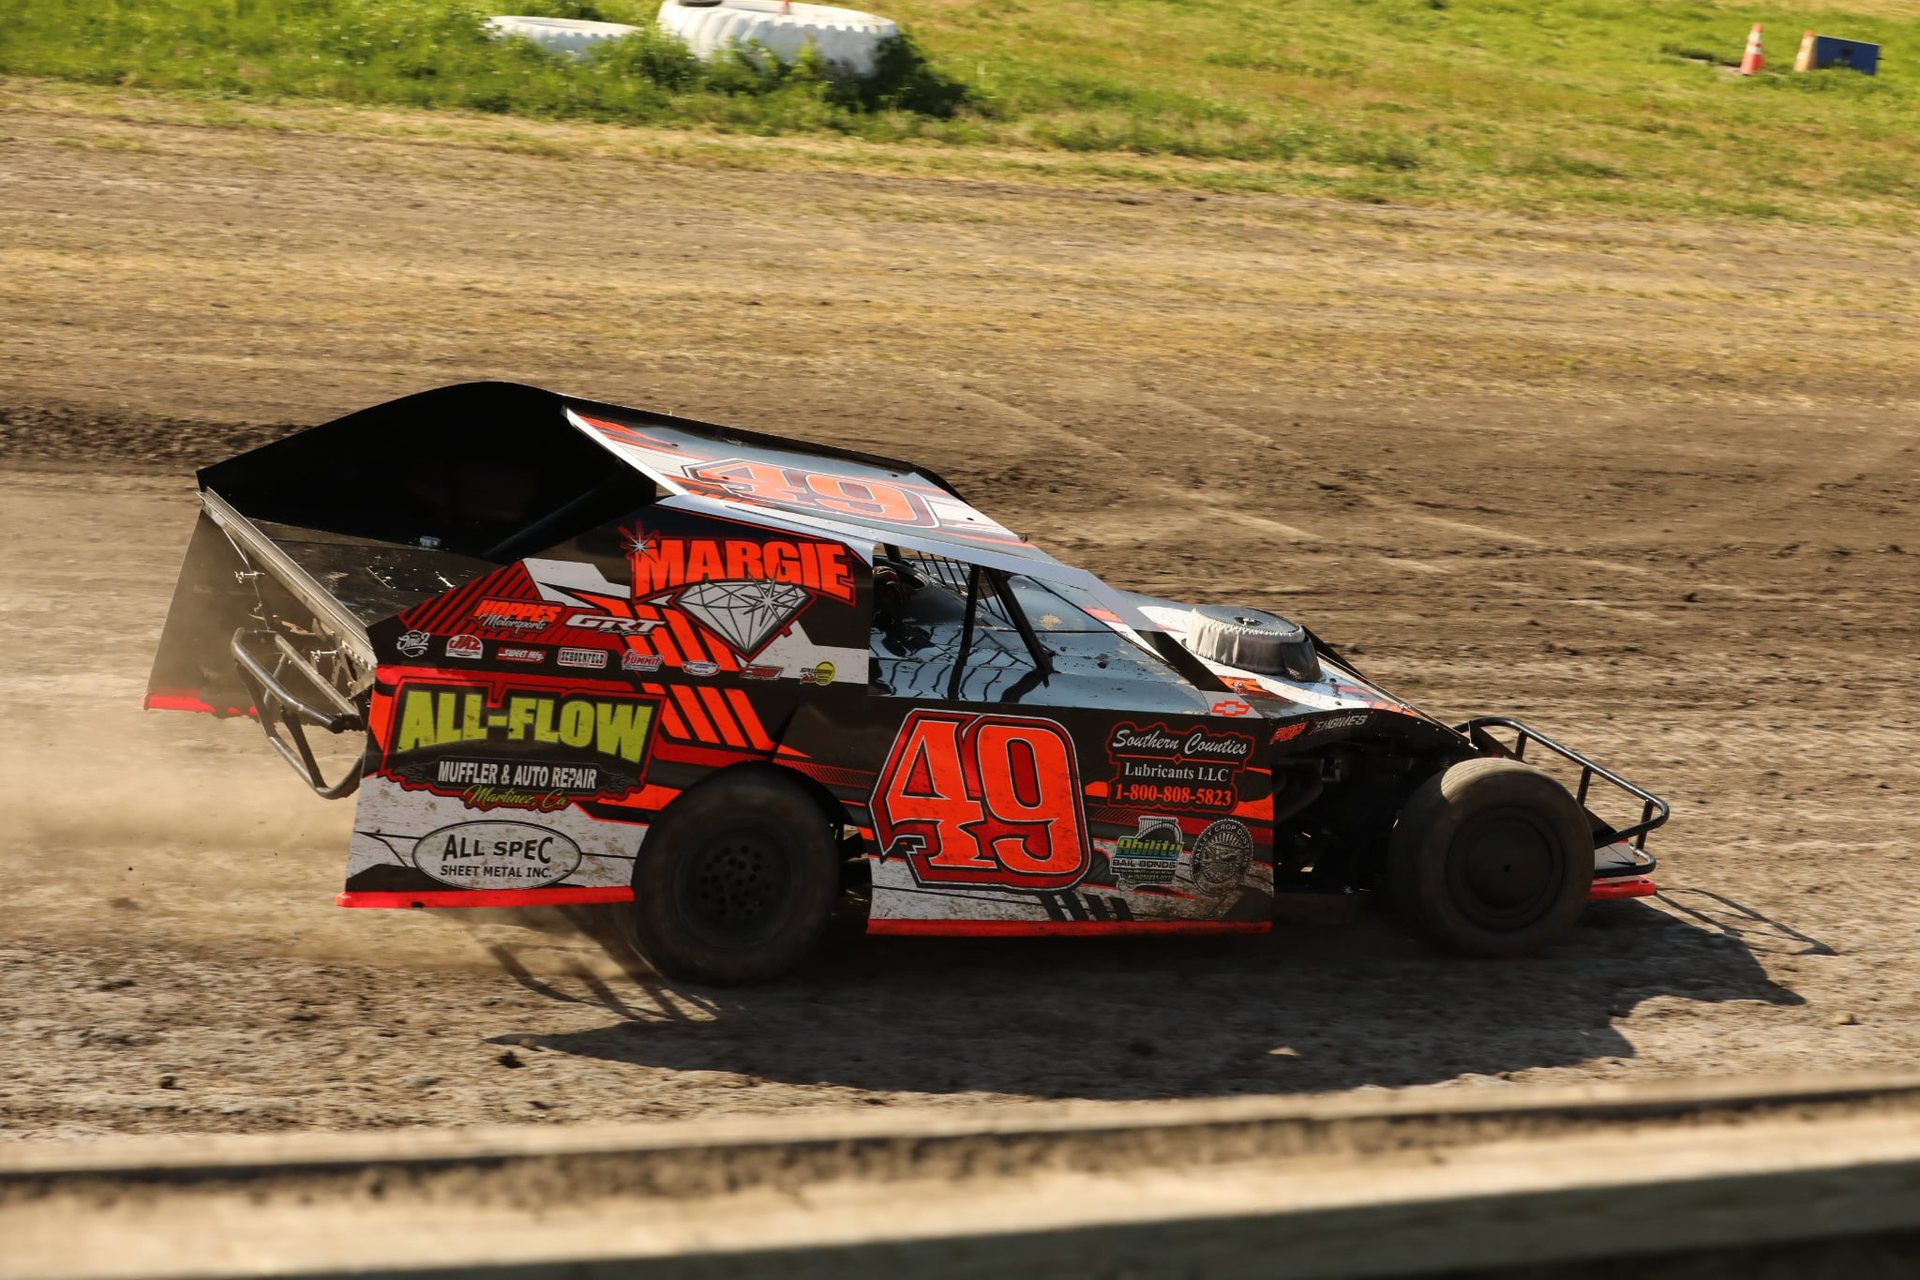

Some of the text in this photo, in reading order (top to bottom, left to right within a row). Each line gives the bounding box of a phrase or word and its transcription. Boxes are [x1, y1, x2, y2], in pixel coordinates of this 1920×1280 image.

[690, 460, 926, 526] 49
[634, 538, 852, 600] MARGIE
[478, 612, 547, 634] Motorsports
[565, 614, 666, 632] GRT
[397, 690, 653, 764] ALL-FLOW
[1112, 729, 1180, 749] Southern
[1184, 732, 1248, 755] Counties
[437, 760, 598, 789] MUFFLER & AUTO REPAIR
[1124, 762, 1229, 782] Lubricants LLC
[878, 714, 1086, 880] 49
[1115, 783, 1232, 806] 1-800-808-5823
[1214, 822, 1237, 833] CROP
[441, 834, 554, 864] ALL SPEC
[440, 864, 552, 879] SHEET METAL INC.
[1112, 859, 1176, 869] BAIL BONDS
